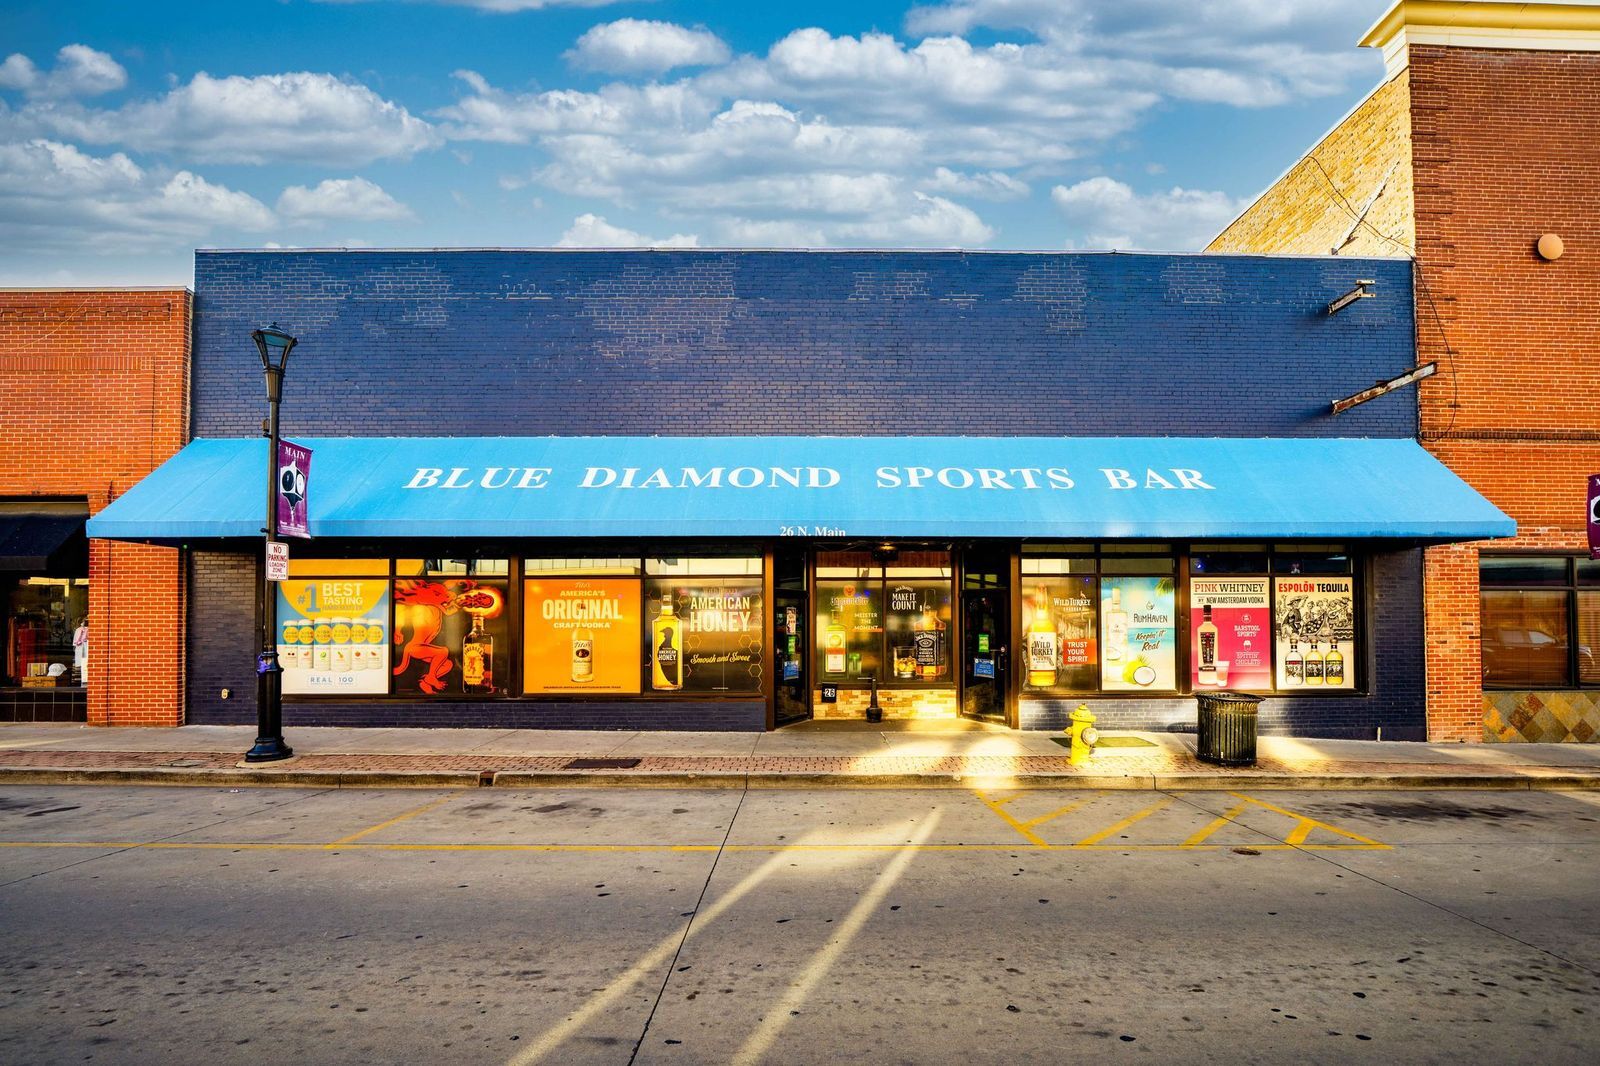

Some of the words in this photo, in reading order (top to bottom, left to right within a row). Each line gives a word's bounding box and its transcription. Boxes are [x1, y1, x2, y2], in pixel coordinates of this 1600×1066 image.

[284, 446, 306, 459] MAIN
[402, 467, 552, 489] BLUE
[577, 467, 841, 489] DIAMOND
[875, 467, 1076, 490] SPORTS
[1097, 468, 1217, 490] BAR
[780, 526, 794, 536] 26
[797, 526, 811, 536] N.
[814, 526, 846, 536] Main
[273, 546, 282, 554] NO
[268, 554, 287, 562] PARKING
[322, 583, 363, 596] BEST
[1194, 584, 1217, 592] PINK
[1219, 584, 1264, 592] WHITNEY
[1317, 584, 1349, 592] TEQUILA
[322, 597, 363, 605] TASTING
[690, 597, 750, 610] AMERICAN
[892, 601, 917, 610] COUNT
[1054, 598, 1069, 606] WILD
[1069, 598, 1092, 606] TURKEY
[542, 599, 623, 619] ORIGINAL
[690, 611, 751, 632] HONEY
[1142, 640, 1160, 651] Real
[1031, 647, 1053, 656] TURKEY
[690, 653, 716, 664] Smooth
[716, 653, 730, 663] and
[730, 651, 750, 662] Sweet
